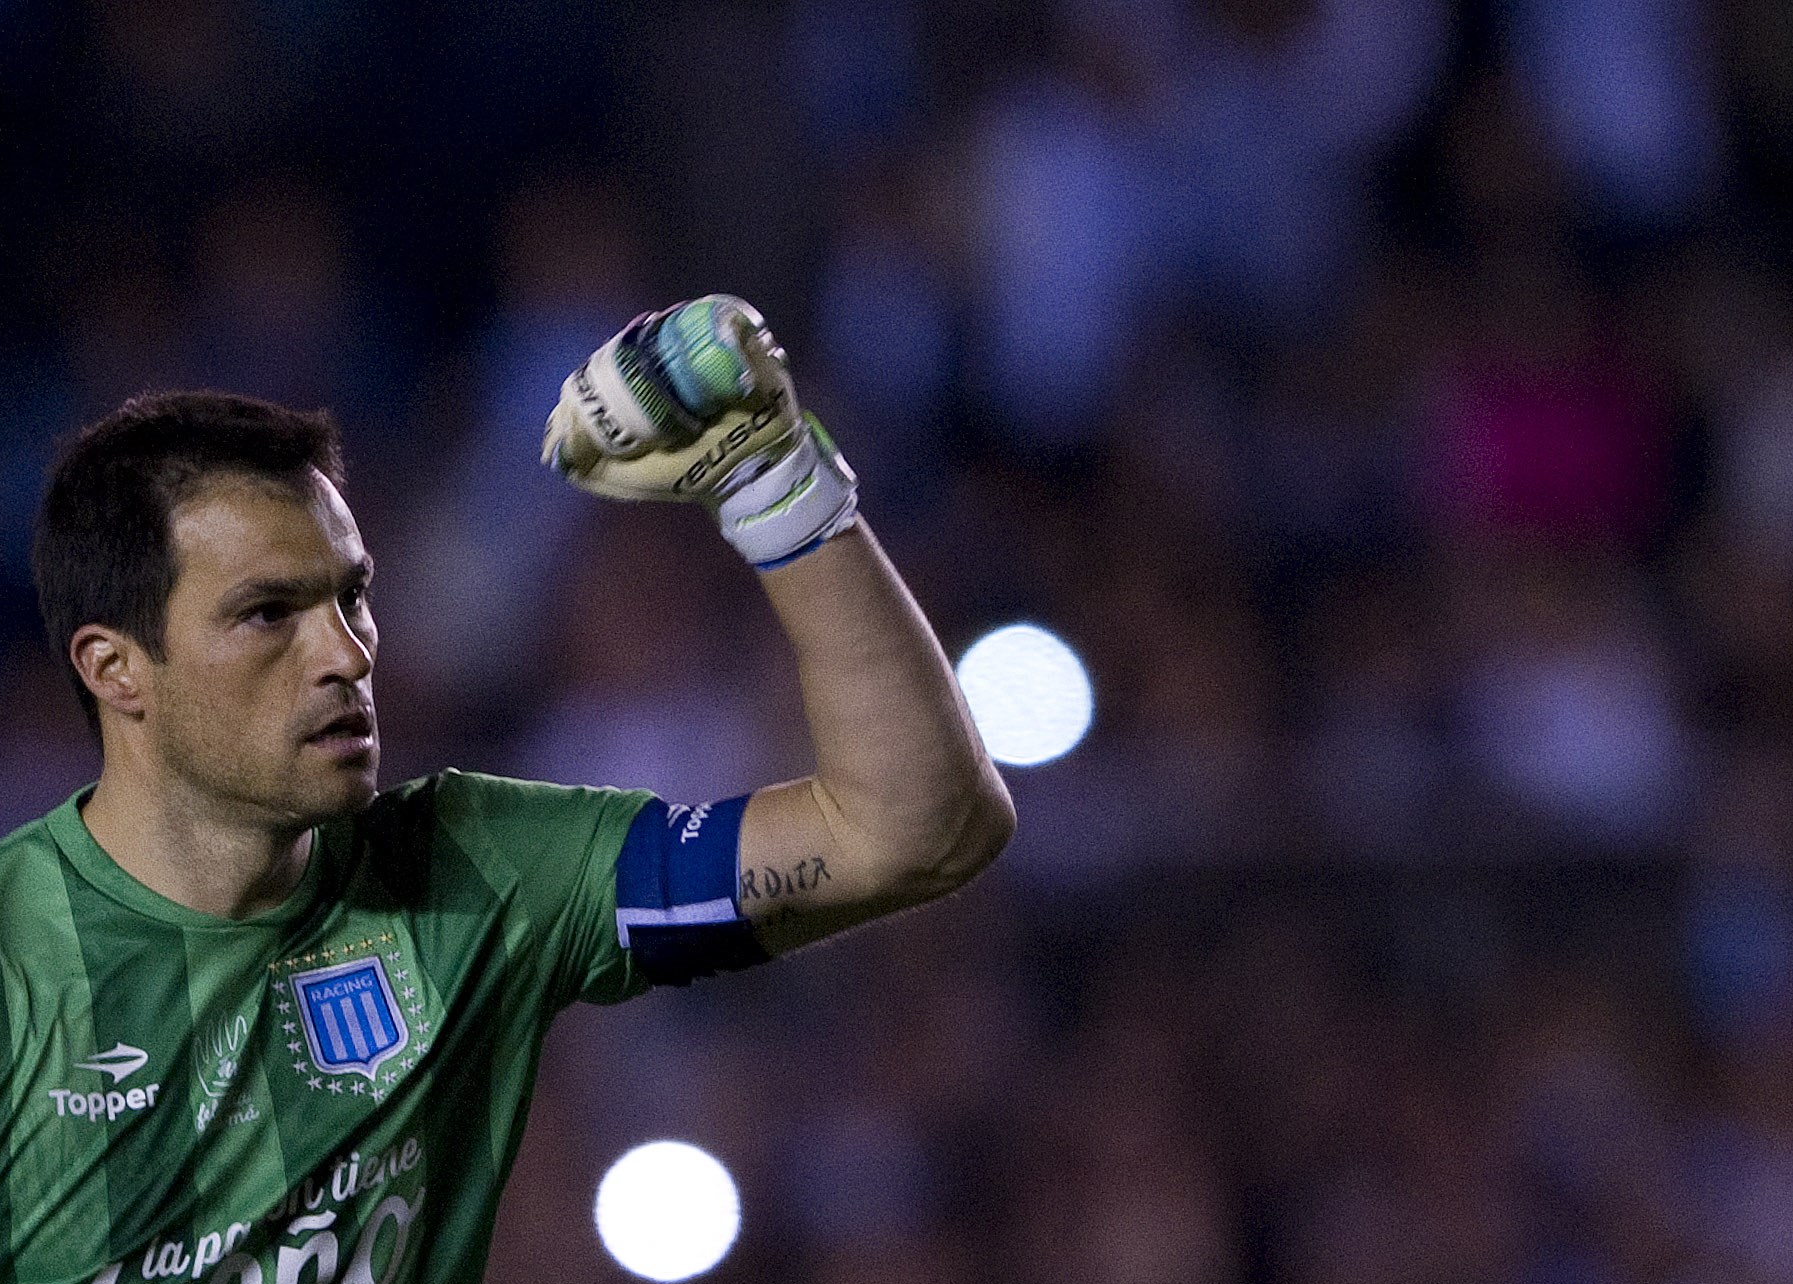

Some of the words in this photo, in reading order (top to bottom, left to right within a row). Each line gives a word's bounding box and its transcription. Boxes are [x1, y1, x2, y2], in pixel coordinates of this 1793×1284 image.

[310, 974, 373, 1003] RACING
[49, 1083, 160, 1122] Topper
[141, 1235, 190, 1280] la
[329, 1137, 422, 1202] tiene
